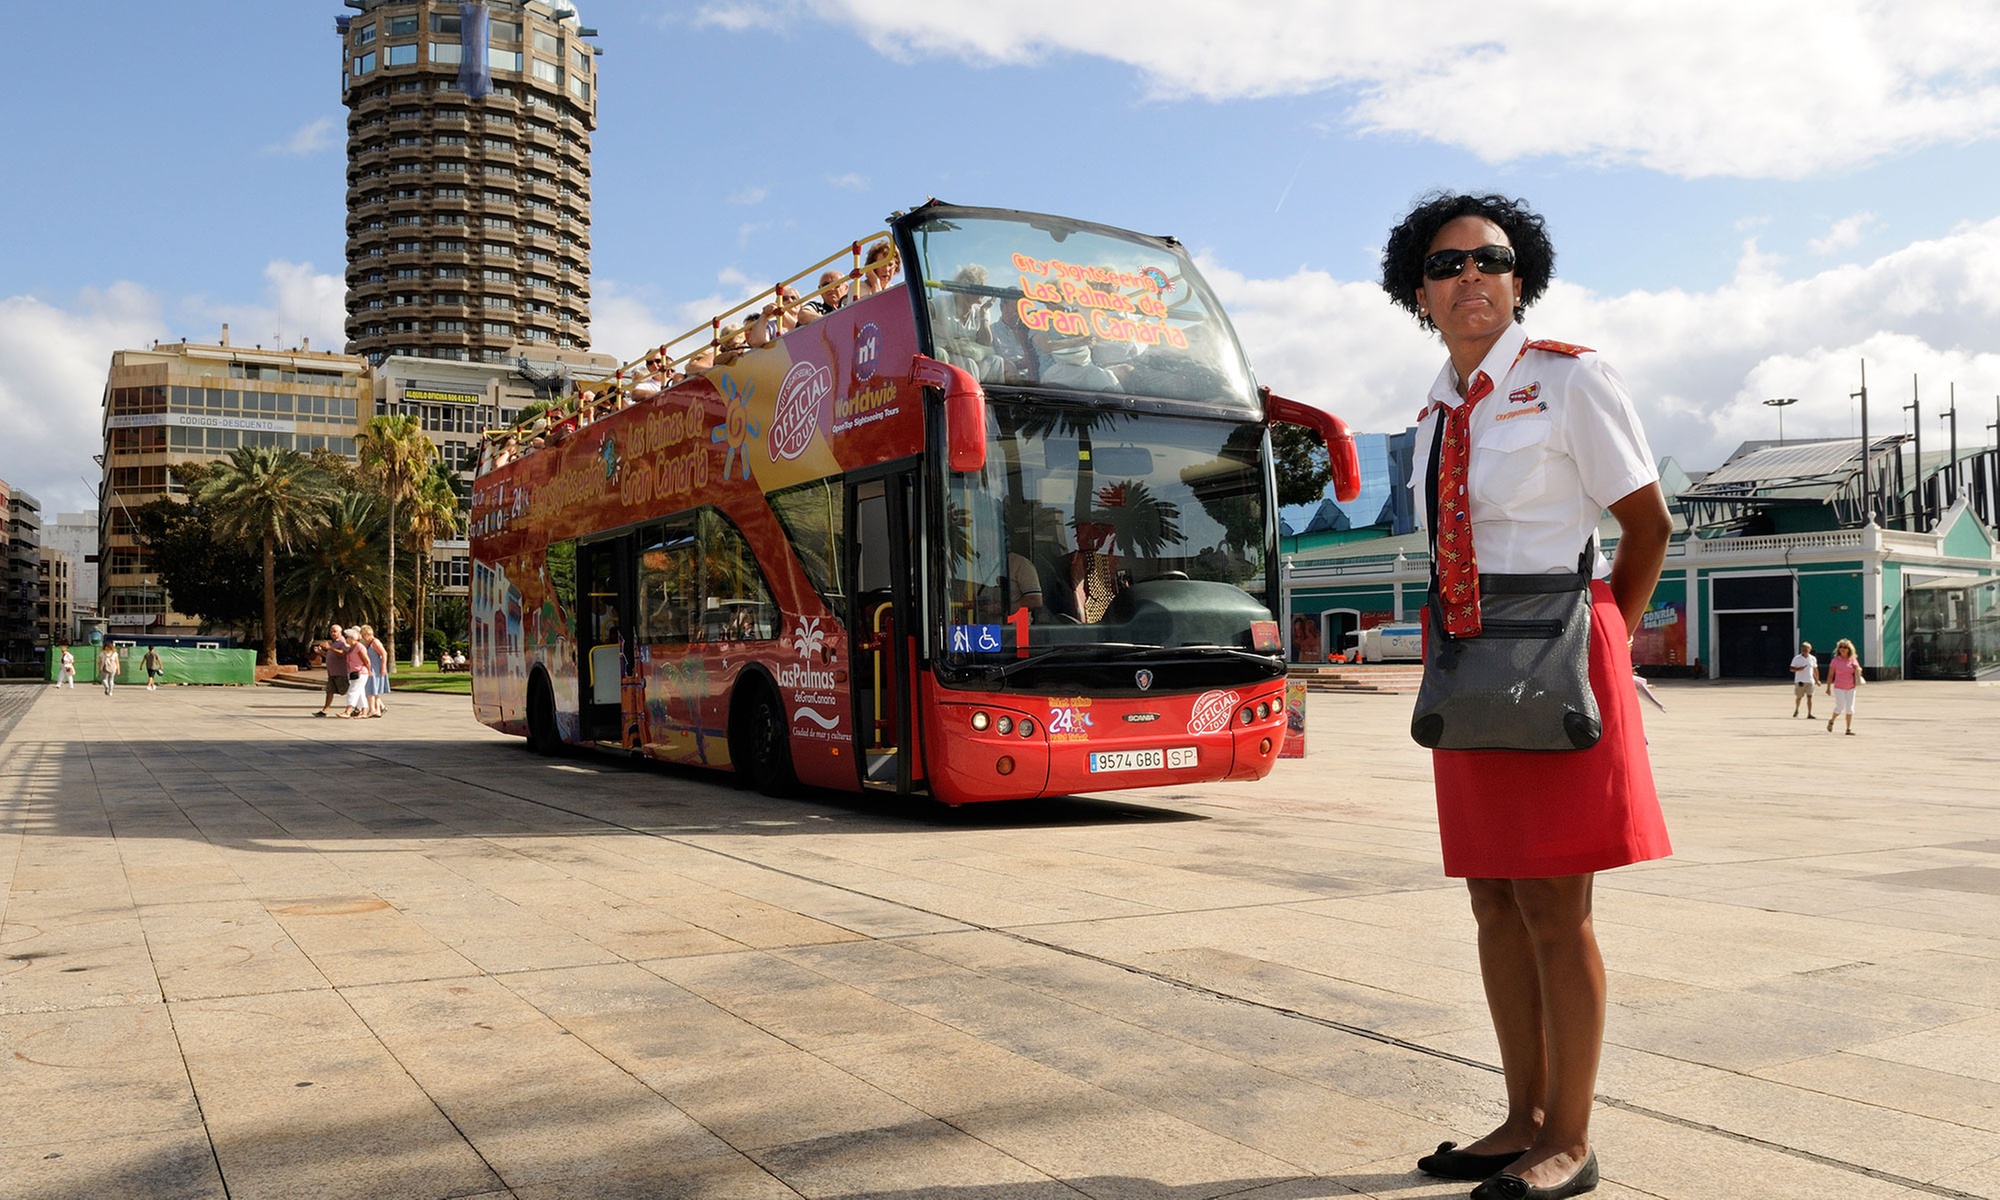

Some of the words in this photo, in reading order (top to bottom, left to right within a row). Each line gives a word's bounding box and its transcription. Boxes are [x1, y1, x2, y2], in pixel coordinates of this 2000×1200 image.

[1012, 253, 1049, 275] City
[1051, 260, 1158, 293] Sightseeing
[1020, 276, 1062, 302] Las
[1060, 281, 1136, 313] Palmas
[1138, 295, 1168, 318] de
[1017, 298, 1090, 336] Gran
[1091, 309, 1188, 349] Canaria
[427, 391, 447, 401] OFICINA
[774, 373, 828, 448] OFFICIAL
[835, 381, 897, 419] Worldwide
[884, 406, 900, 418] Tours
[627, 422, 646, 460] Las
[646, 409, 685, 454] Palmas
[686, 396, 704, 439] de
[791, 413, 815, 450] TOUR
[621, 461, 653, 507] Gran
[654, 441, 709, 500] Canaria
[1007, 606, 1030, 659] 1
[777, 661, 835, 689] LasPalmas
[795, 691, 836, 705] deGranCanaria
[1193, 693, 1236, 732] OFFICIAL
[1049, 707, 1073, 733] 24
[1128, 714, 1155, 722] SCANIA
[1209, 711, 1229, 731] TOUR
[1100, 754, 1132, 769] 9574
[1136, 752, 1161, 767] GBG
[1171, 750, 1194, 766] SP
